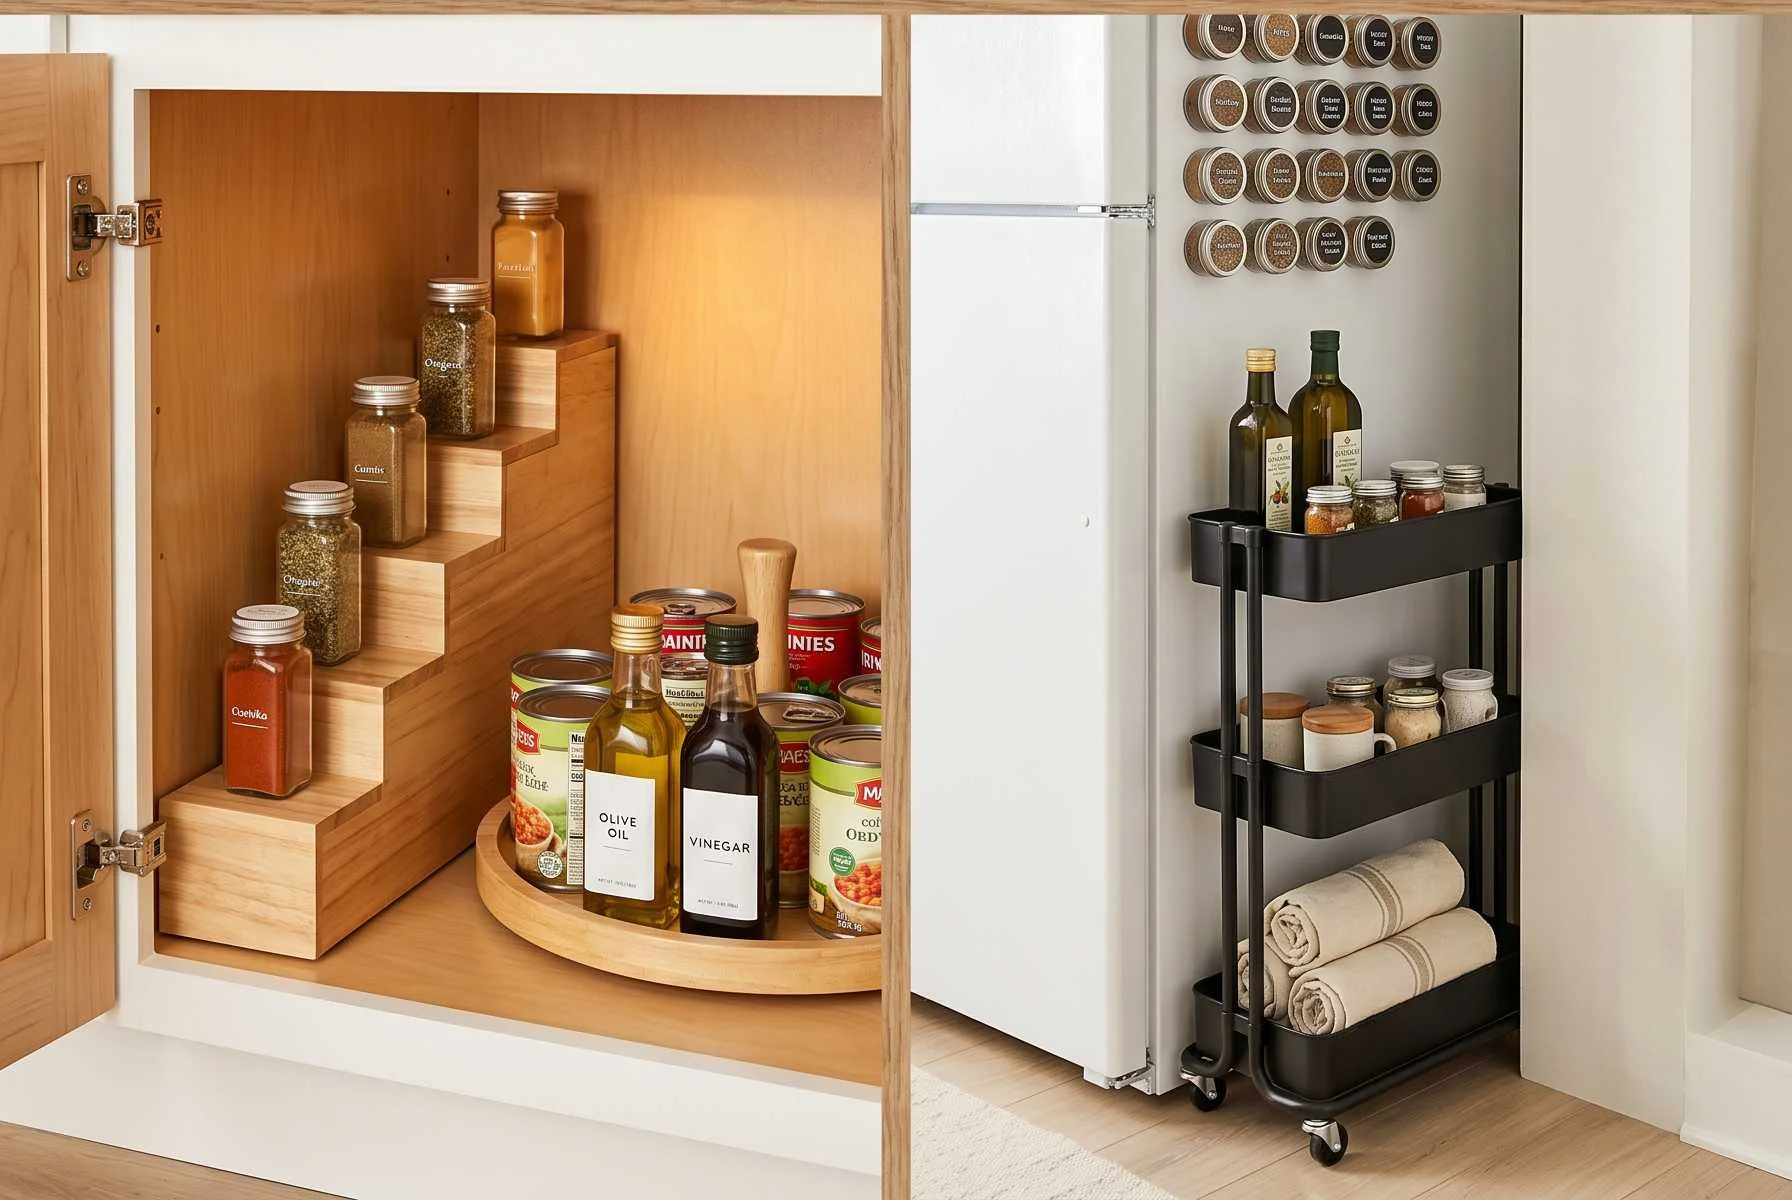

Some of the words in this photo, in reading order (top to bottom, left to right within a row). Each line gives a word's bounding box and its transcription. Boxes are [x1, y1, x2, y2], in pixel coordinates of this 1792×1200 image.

[599, 812, 638, 828] OLIVE
[607, 828, 629, 841] OIL
[689, 835, 751, 854] VINEGAR
